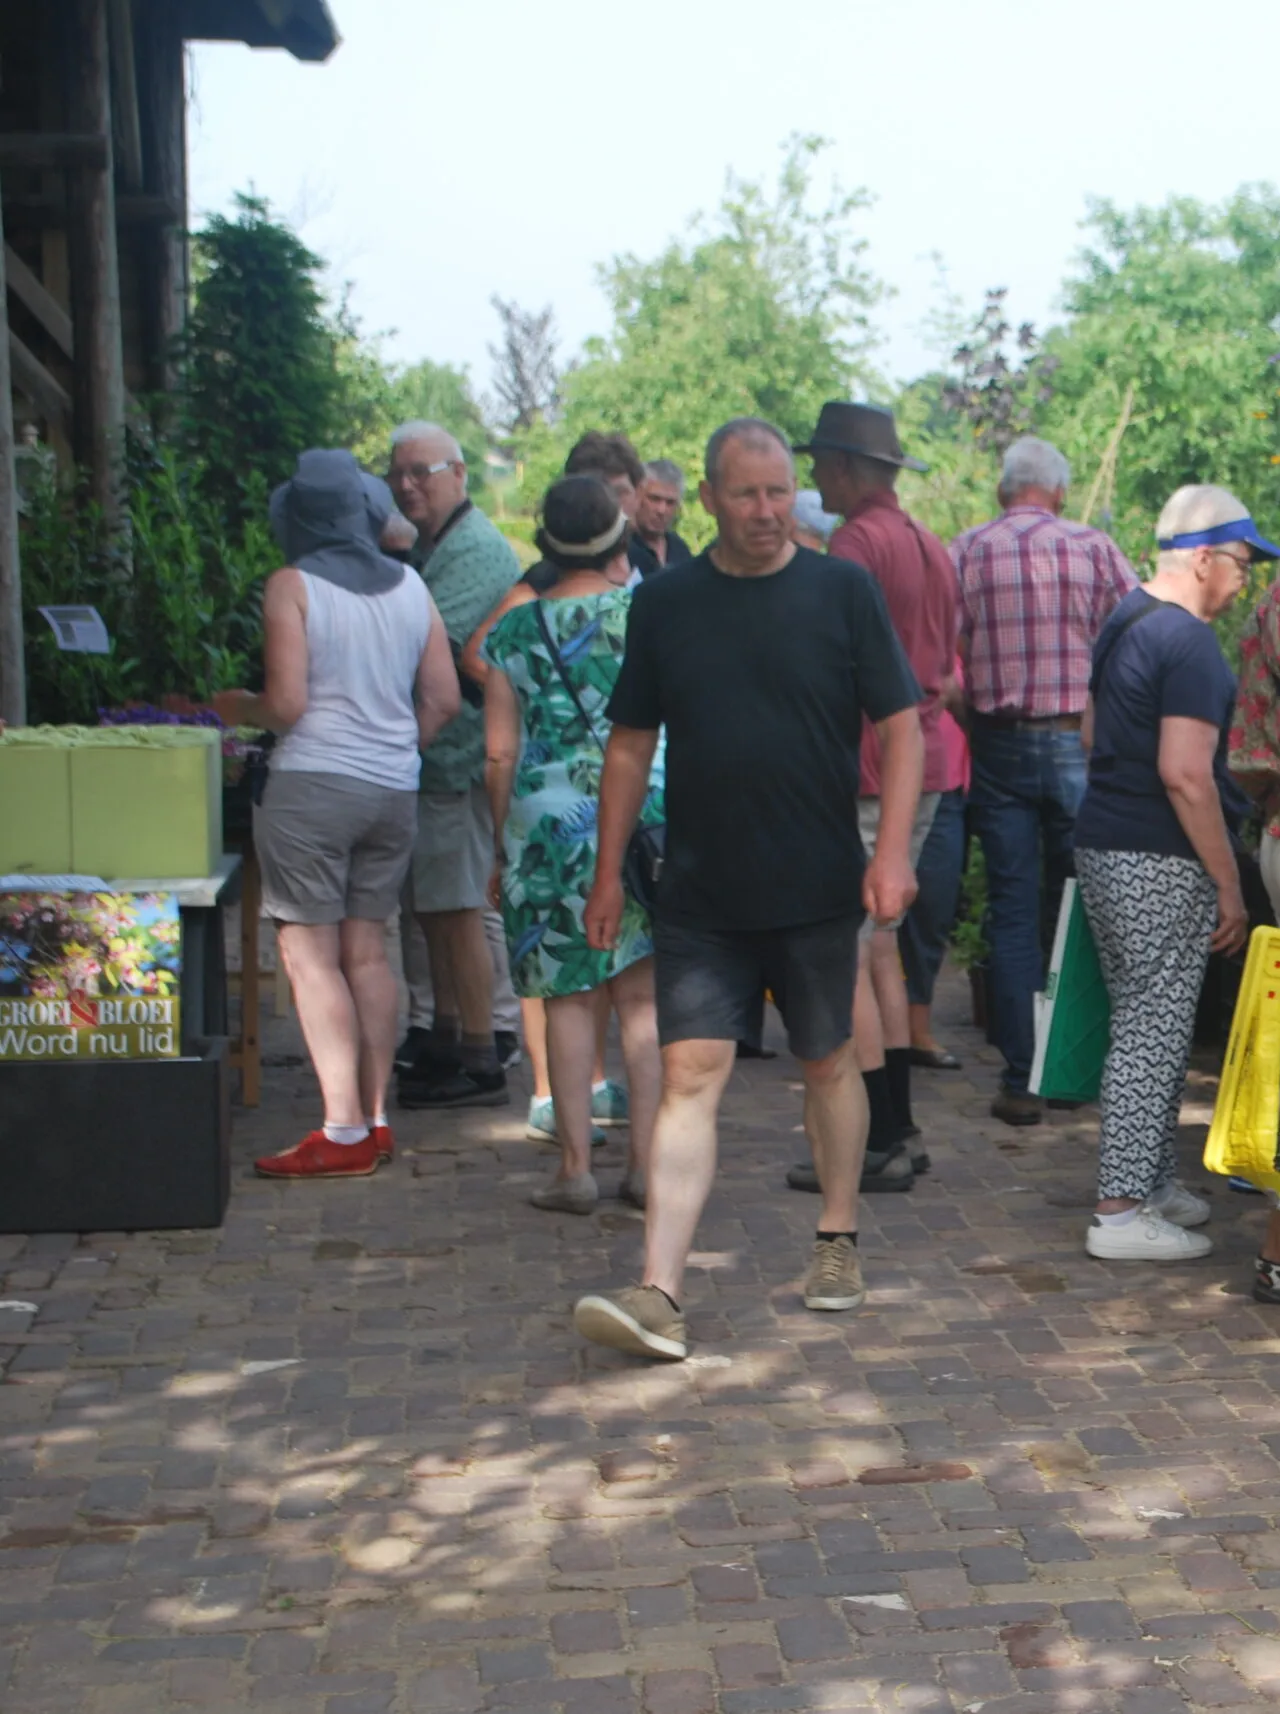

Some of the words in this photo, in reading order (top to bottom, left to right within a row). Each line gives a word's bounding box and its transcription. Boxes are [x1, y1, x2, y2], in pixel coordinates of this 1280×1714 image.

[99, 999, 174, 1025] BLOEI
[0, 1026, 78, 1055] Word
[89, 1034, 128, 1054] nu
[139, 1026, 174, 1053] lid
